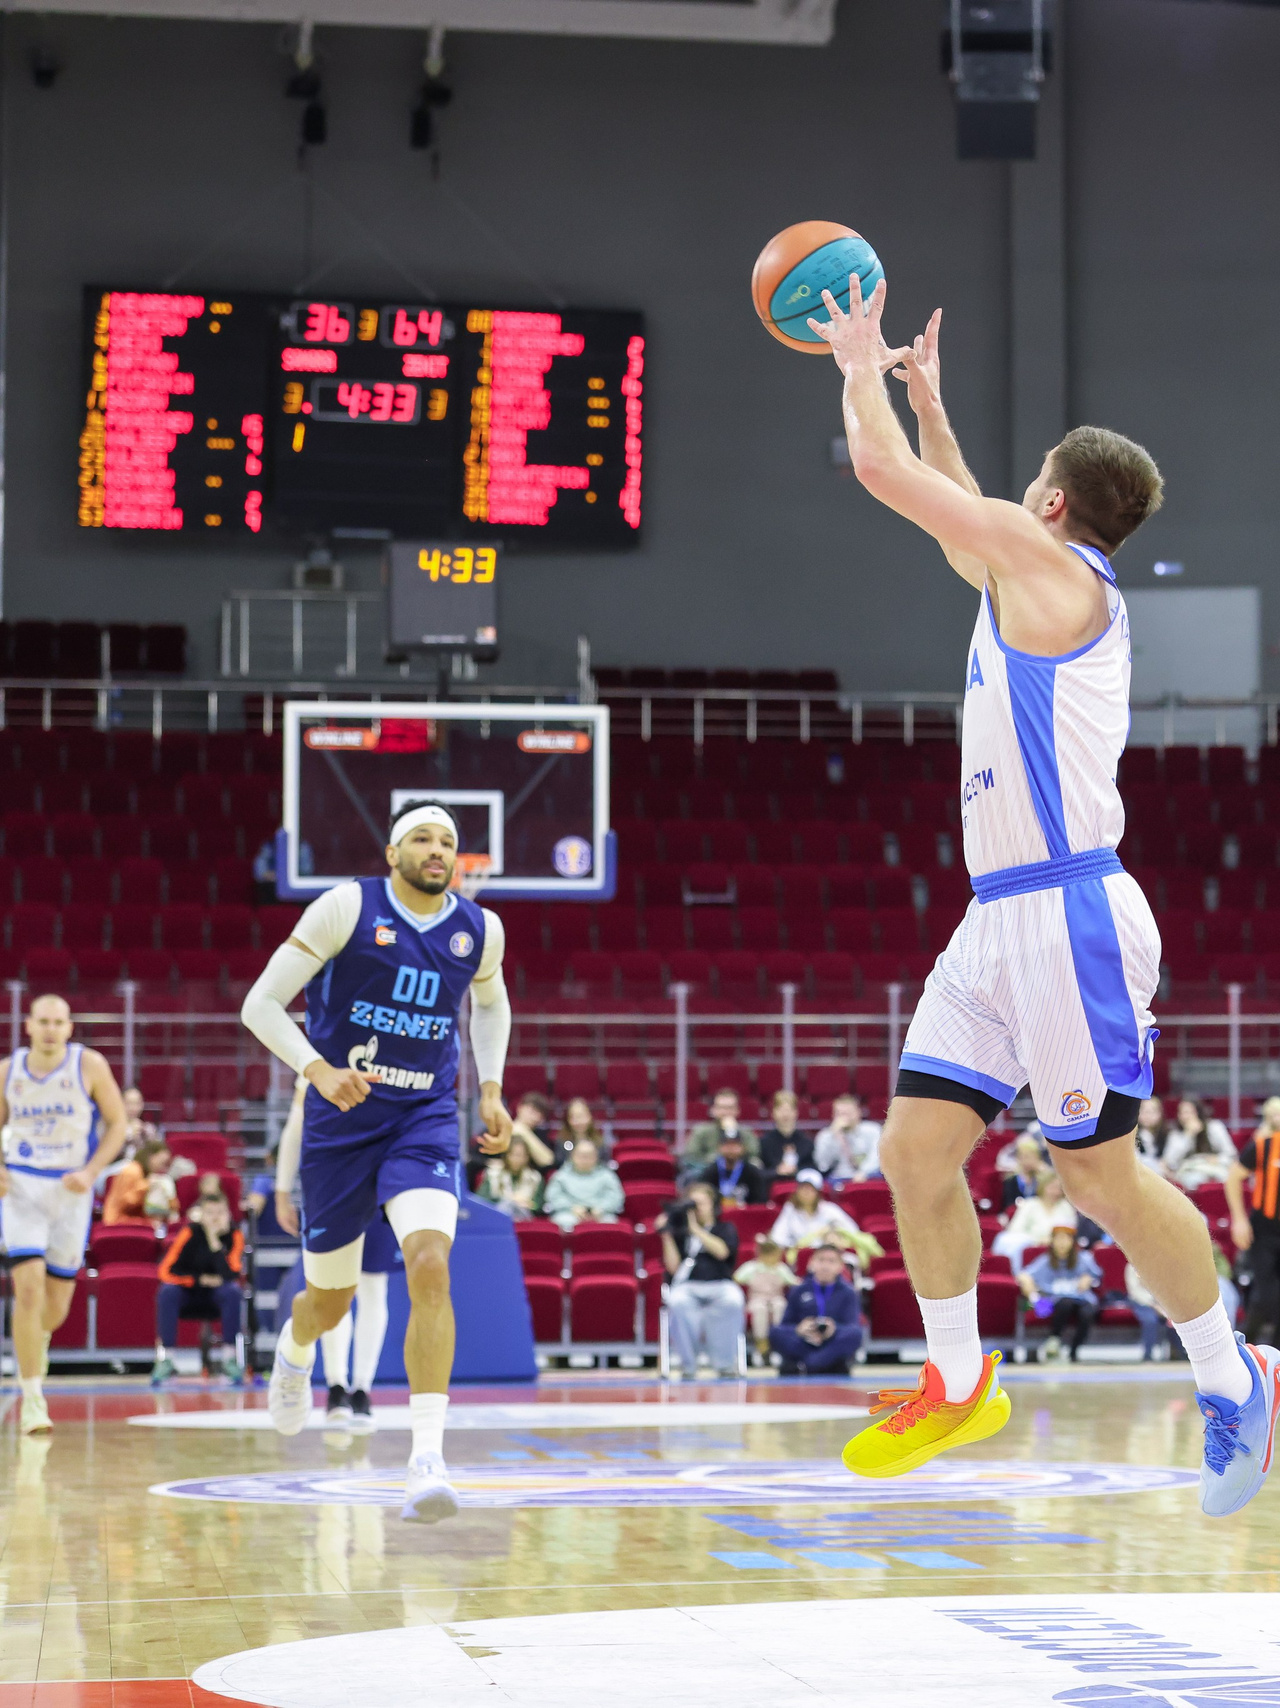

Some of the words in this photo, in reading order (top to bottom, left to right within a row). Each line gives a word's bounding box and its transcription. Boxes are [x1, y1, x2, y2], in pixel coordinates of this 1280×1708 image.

[304, 303, 350, 343] 36
[393, 309, 443, 346] 64
[337, 382, 417, 422] 4:33
[418, 547, 497, 583] 4:33
[392, 965, 441, 1008] 00
[350, 1000, 452, 1040] ZENIT
[932, 1606, 1259, 1673] РОССЕТИ
